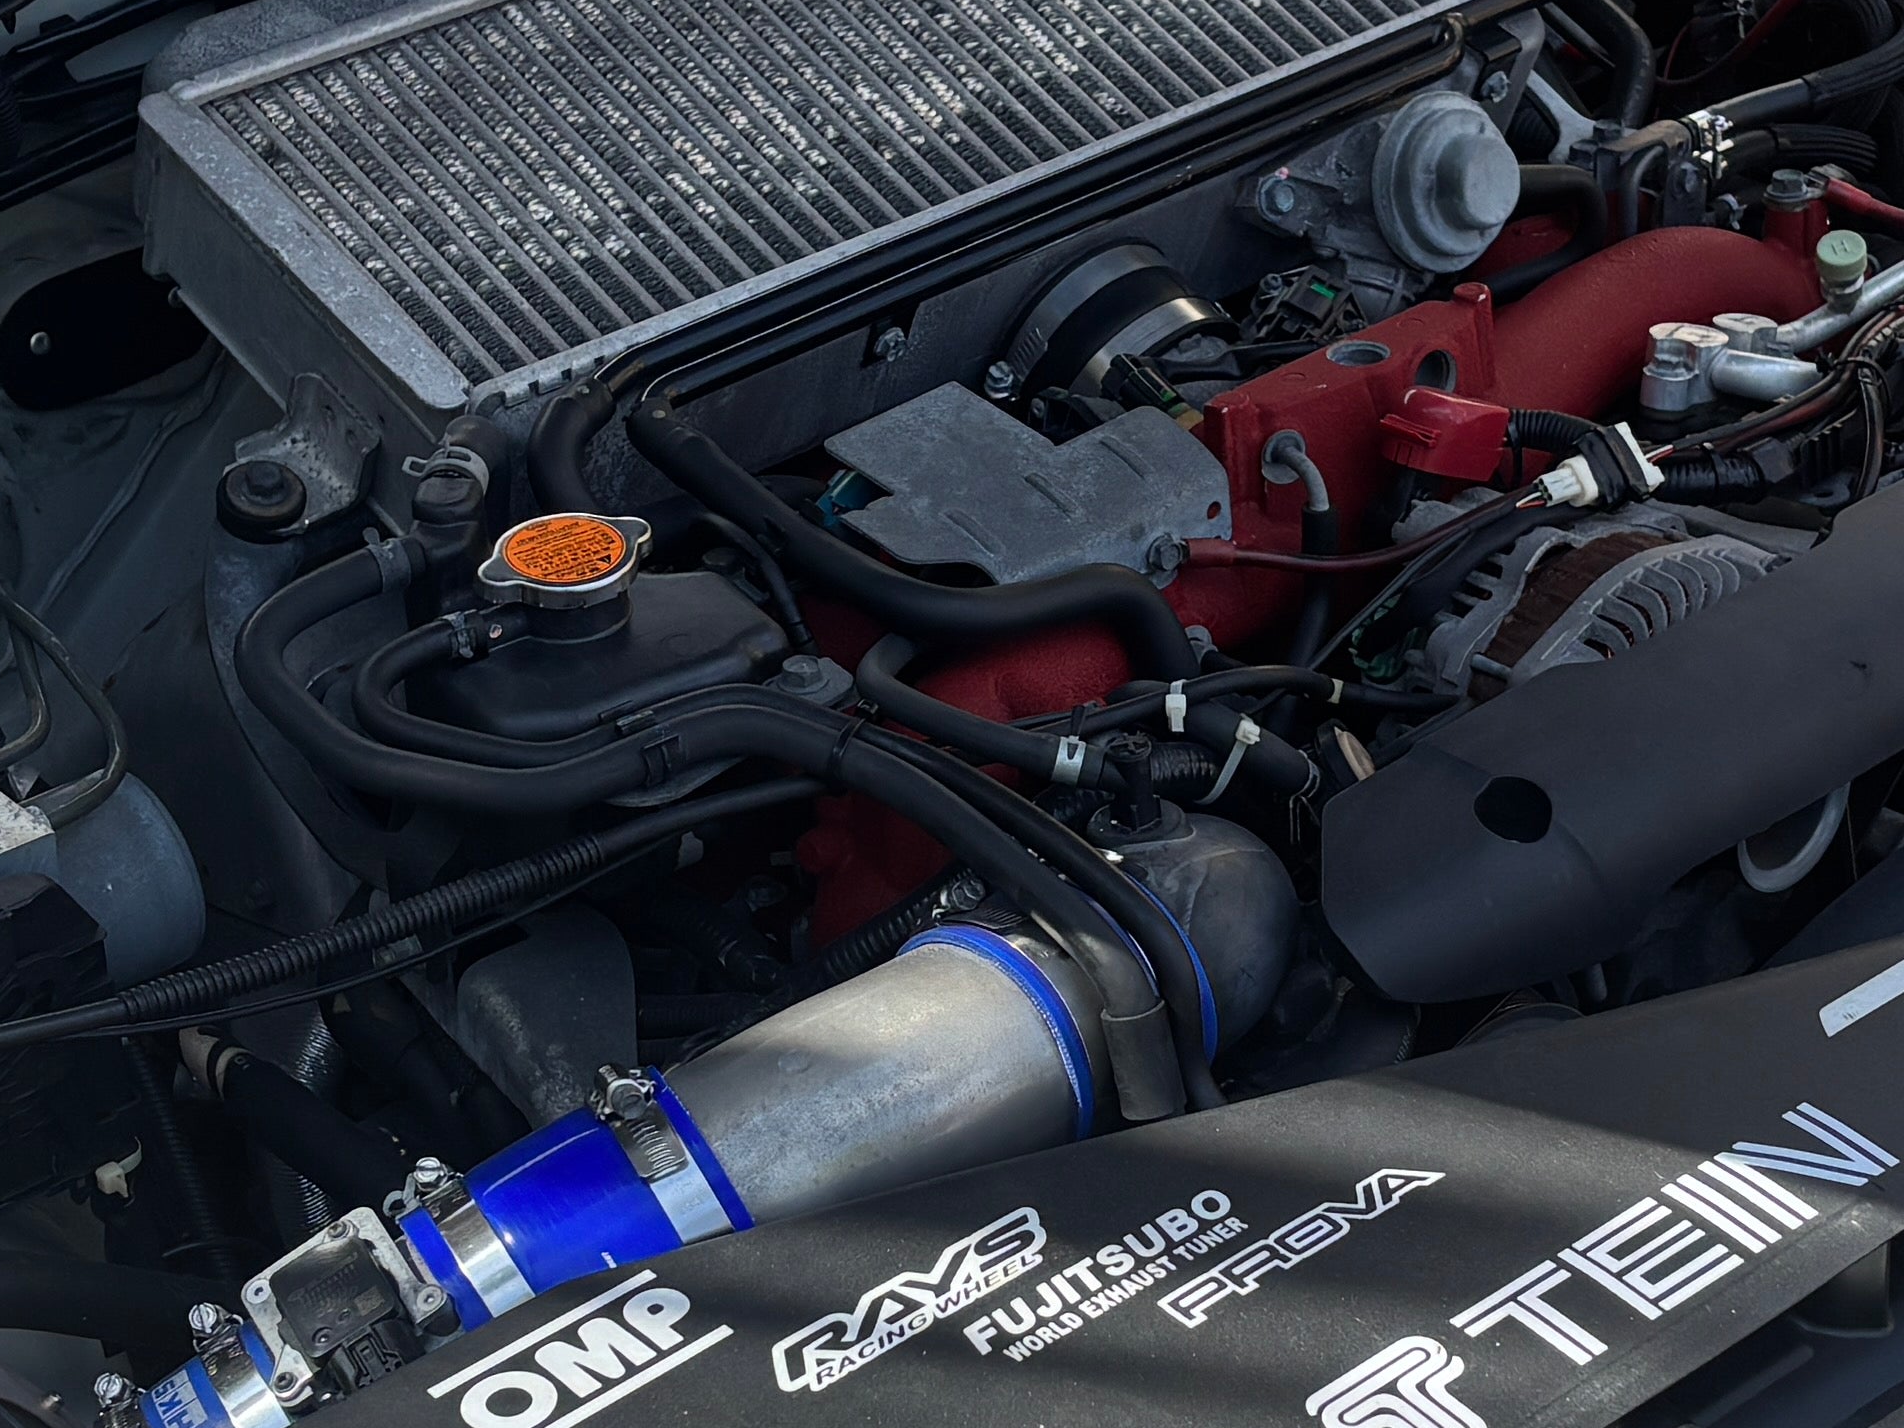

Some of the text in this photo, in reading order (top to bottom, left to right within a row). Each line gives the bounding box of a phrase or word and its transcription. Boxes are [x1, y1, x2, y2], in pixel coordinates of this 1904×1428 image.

[776, 1210, 1043, 1388] RAYS
[962, 1188, 1232, 1356] FUJITSUBO
[1001, 1215, 1250, 1363] WORLD EXHAUST TUNER
[1156, 1167, 1447, 1329] PROVA
[1449, 1101, 1901, 1367] TEIN
[815, 1253, 1037, 1387] RACING WHEEL
